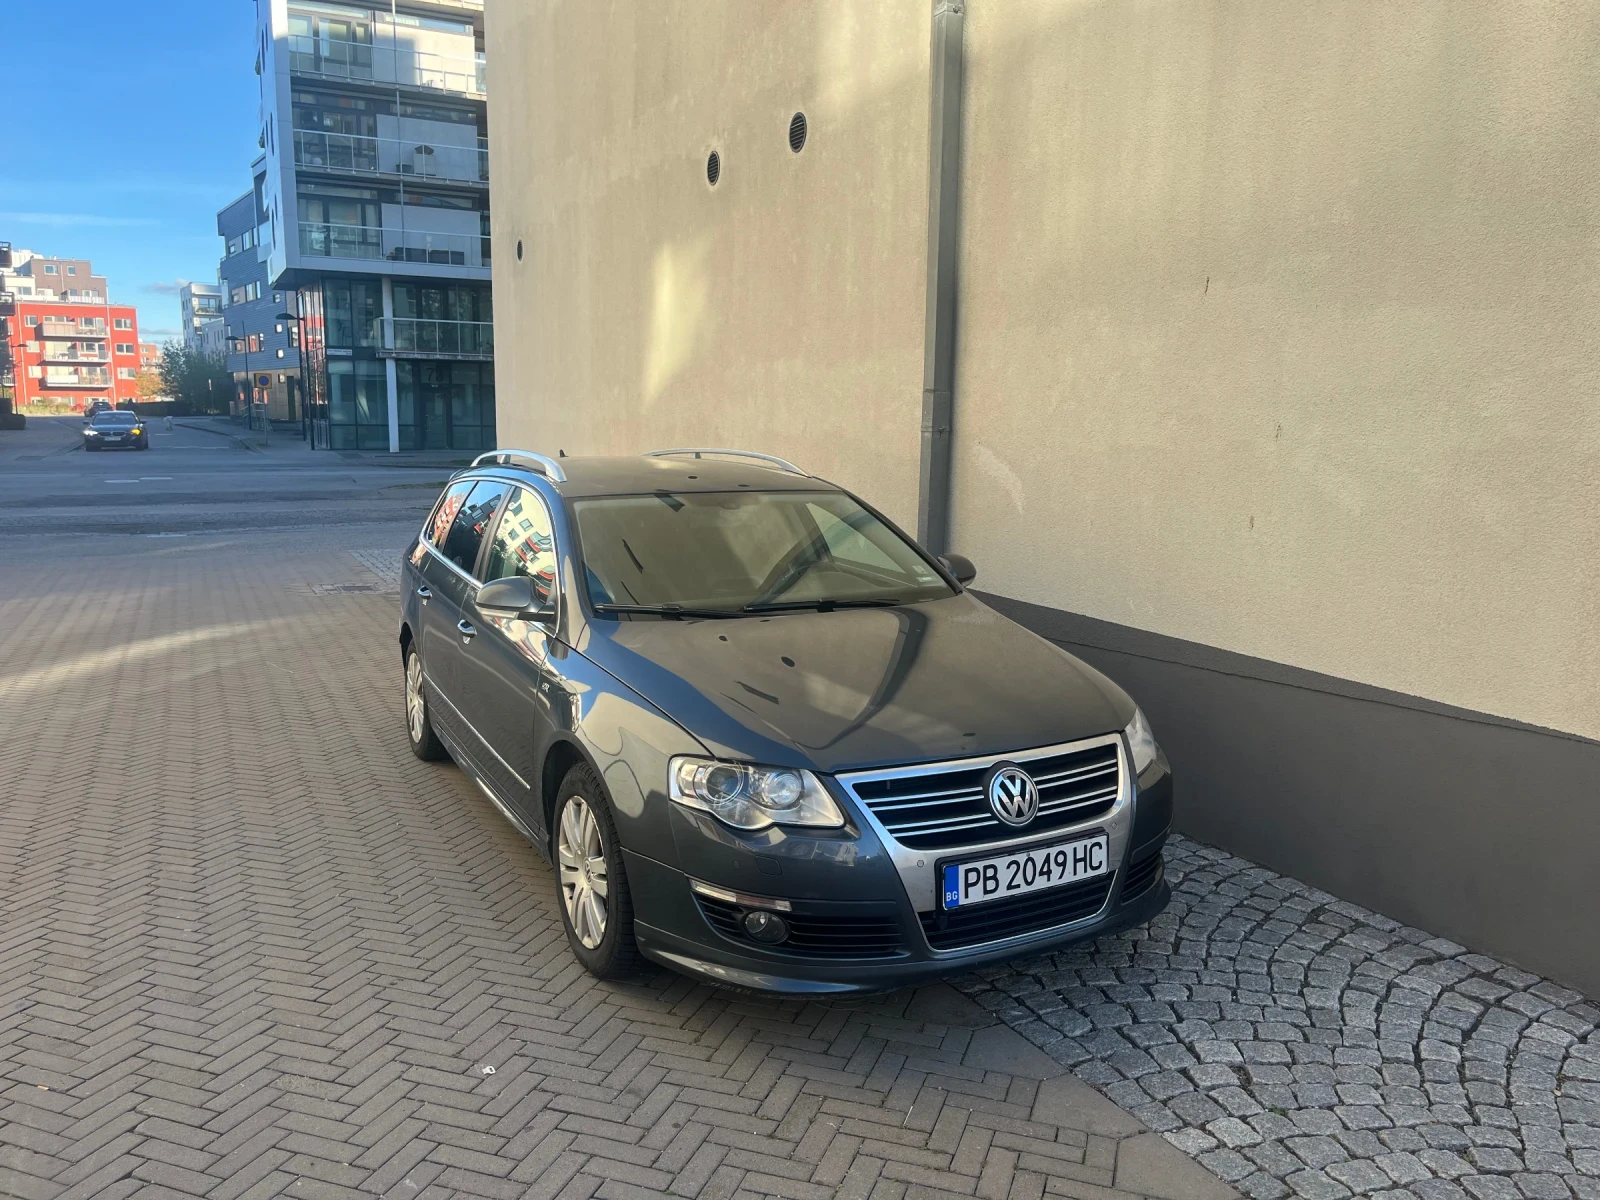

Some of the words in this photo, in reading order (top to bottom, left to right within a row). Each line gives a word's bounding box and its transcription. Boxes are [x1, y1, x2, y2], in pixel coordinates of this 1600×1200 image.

[992, 770, 1037, 823] VW
[946, 890, 958, 902] BG
[964, 865, 1000, 899] PB
[1006, 850, 1068, 891] 2049
[1073, 841, 1103, 876] HC
